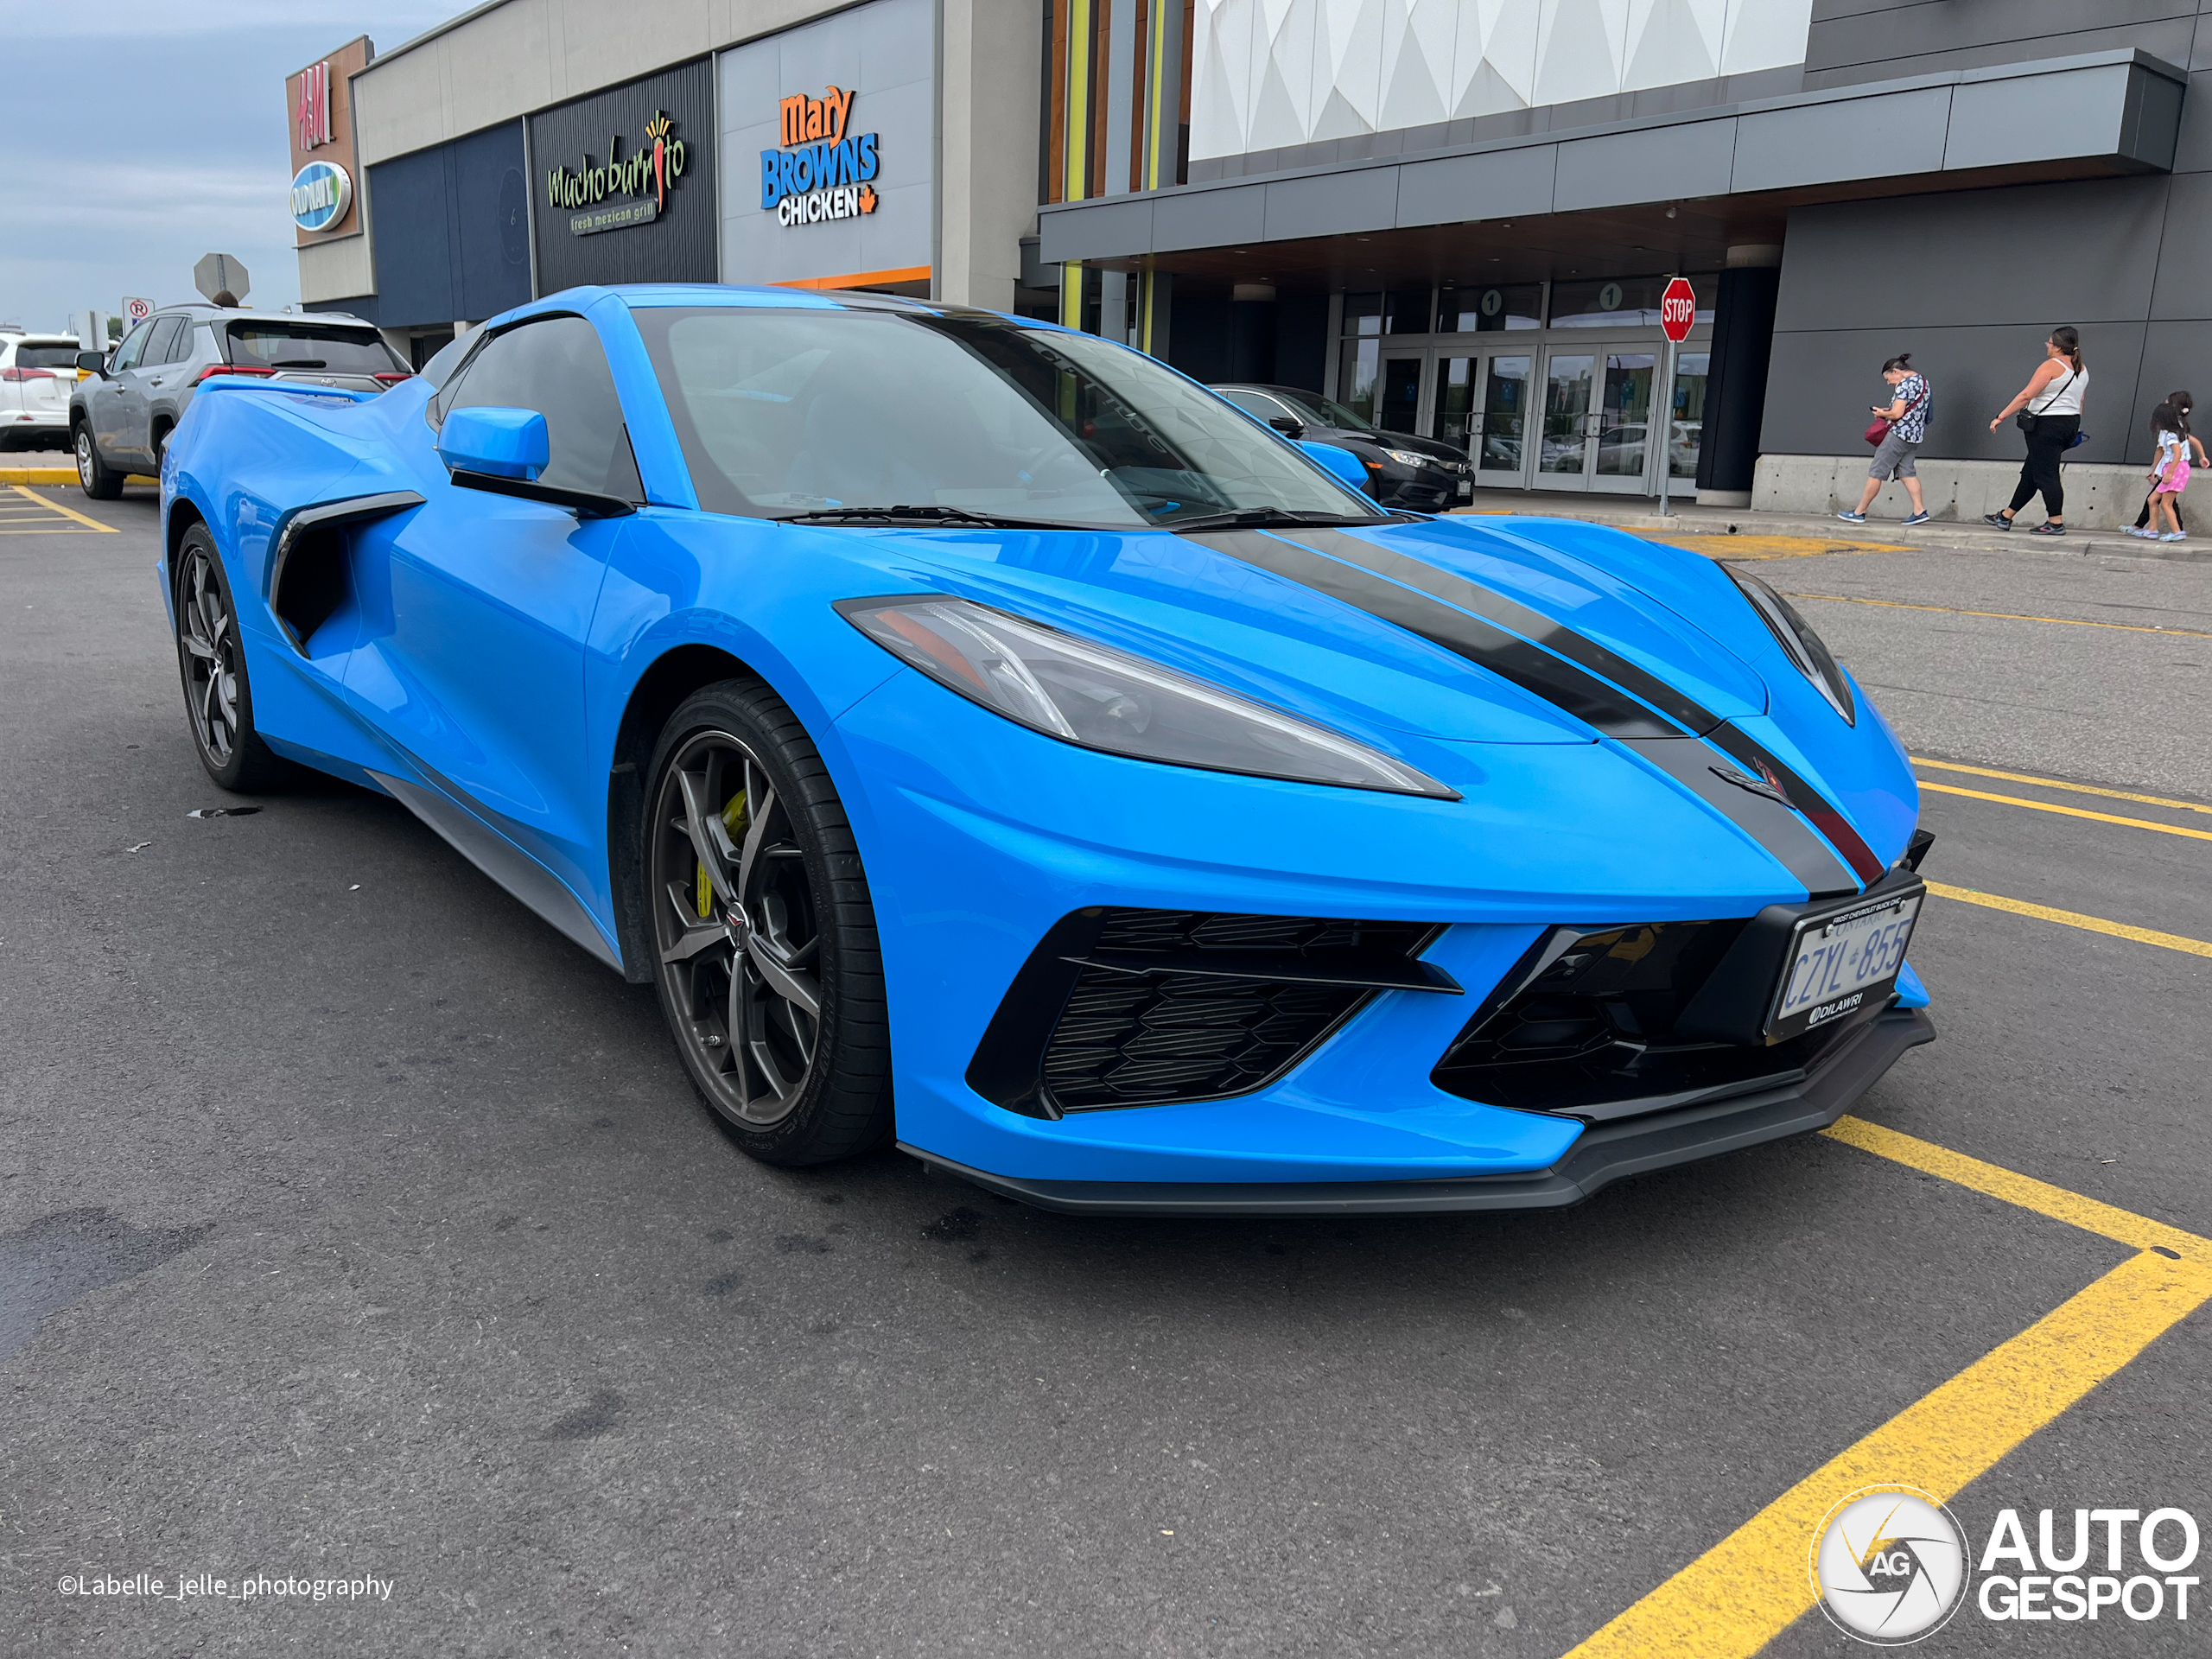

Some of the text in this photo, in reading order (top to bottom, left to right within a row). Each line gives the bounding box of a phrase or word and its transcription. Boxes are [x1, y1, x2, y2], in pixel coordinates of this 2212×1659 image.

[779, 85, 853, 149] Mary
[607, 134, 684, 213] burrito
[291, 175, 334, 217] OLD NAVY
[778, 187, 858, 227] CHICKEN
[570, 202, 653, 232] fresh mexican grill
[1487, 293, 1495, 311] 1
[1606, 287, 1614, 306] 1
[1663, 297, 1694, 323] STOP
[1835, 911, 1886, 938] ONTARIO
[1848, 905, 1877, 919] CHEVROLET
[1785, 918, 1912, 1009] CZYL 855
[1819, 992, 1864, 1020] DILAWRI
